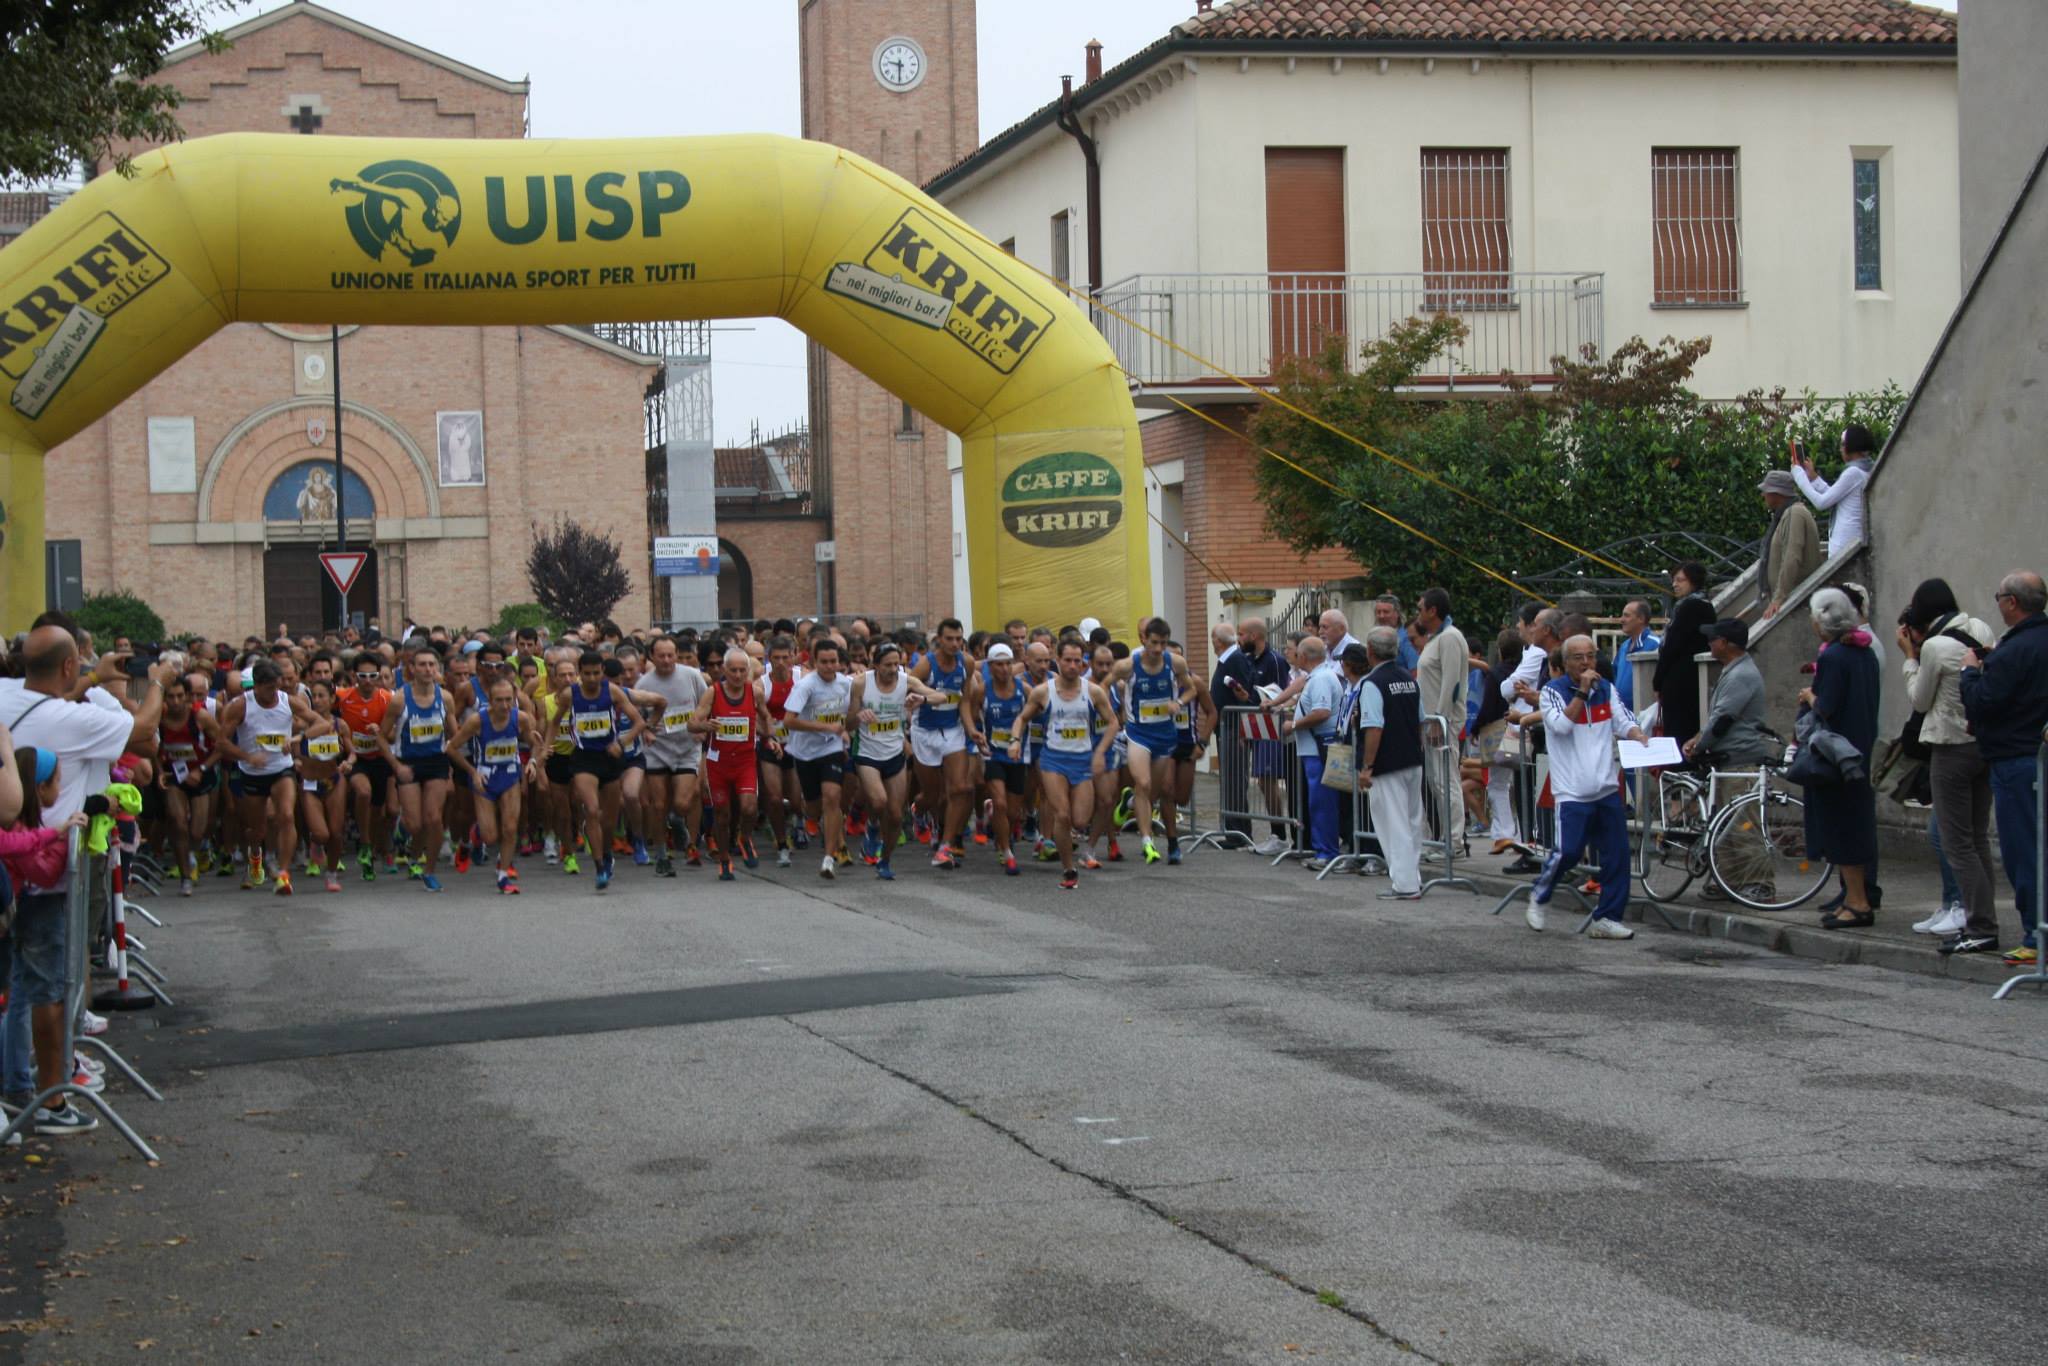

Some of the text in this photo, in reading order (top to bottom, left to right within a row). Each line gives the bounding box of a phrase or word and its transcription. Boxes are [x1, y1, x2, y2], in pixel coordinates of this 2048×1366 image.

[485, 170, 692, 246] UISP
[96, 264, 150, 314] caffé
[331, 262, 696, 290] UNIONE ITALIANA SPORT PER TUTTI
[846, 276, 867, 292] nei
[868, 285, 913, 310] migliori
[882, 223, 1039, 353] KRIFI
[948, 316, 1008, 363] caffé
[30, 379, 46, 400] nei
[42, 339, 74, 382] migliori
[1016, 510, 1110, 534] KRIFI
[723, 725, 743, 735] 190
